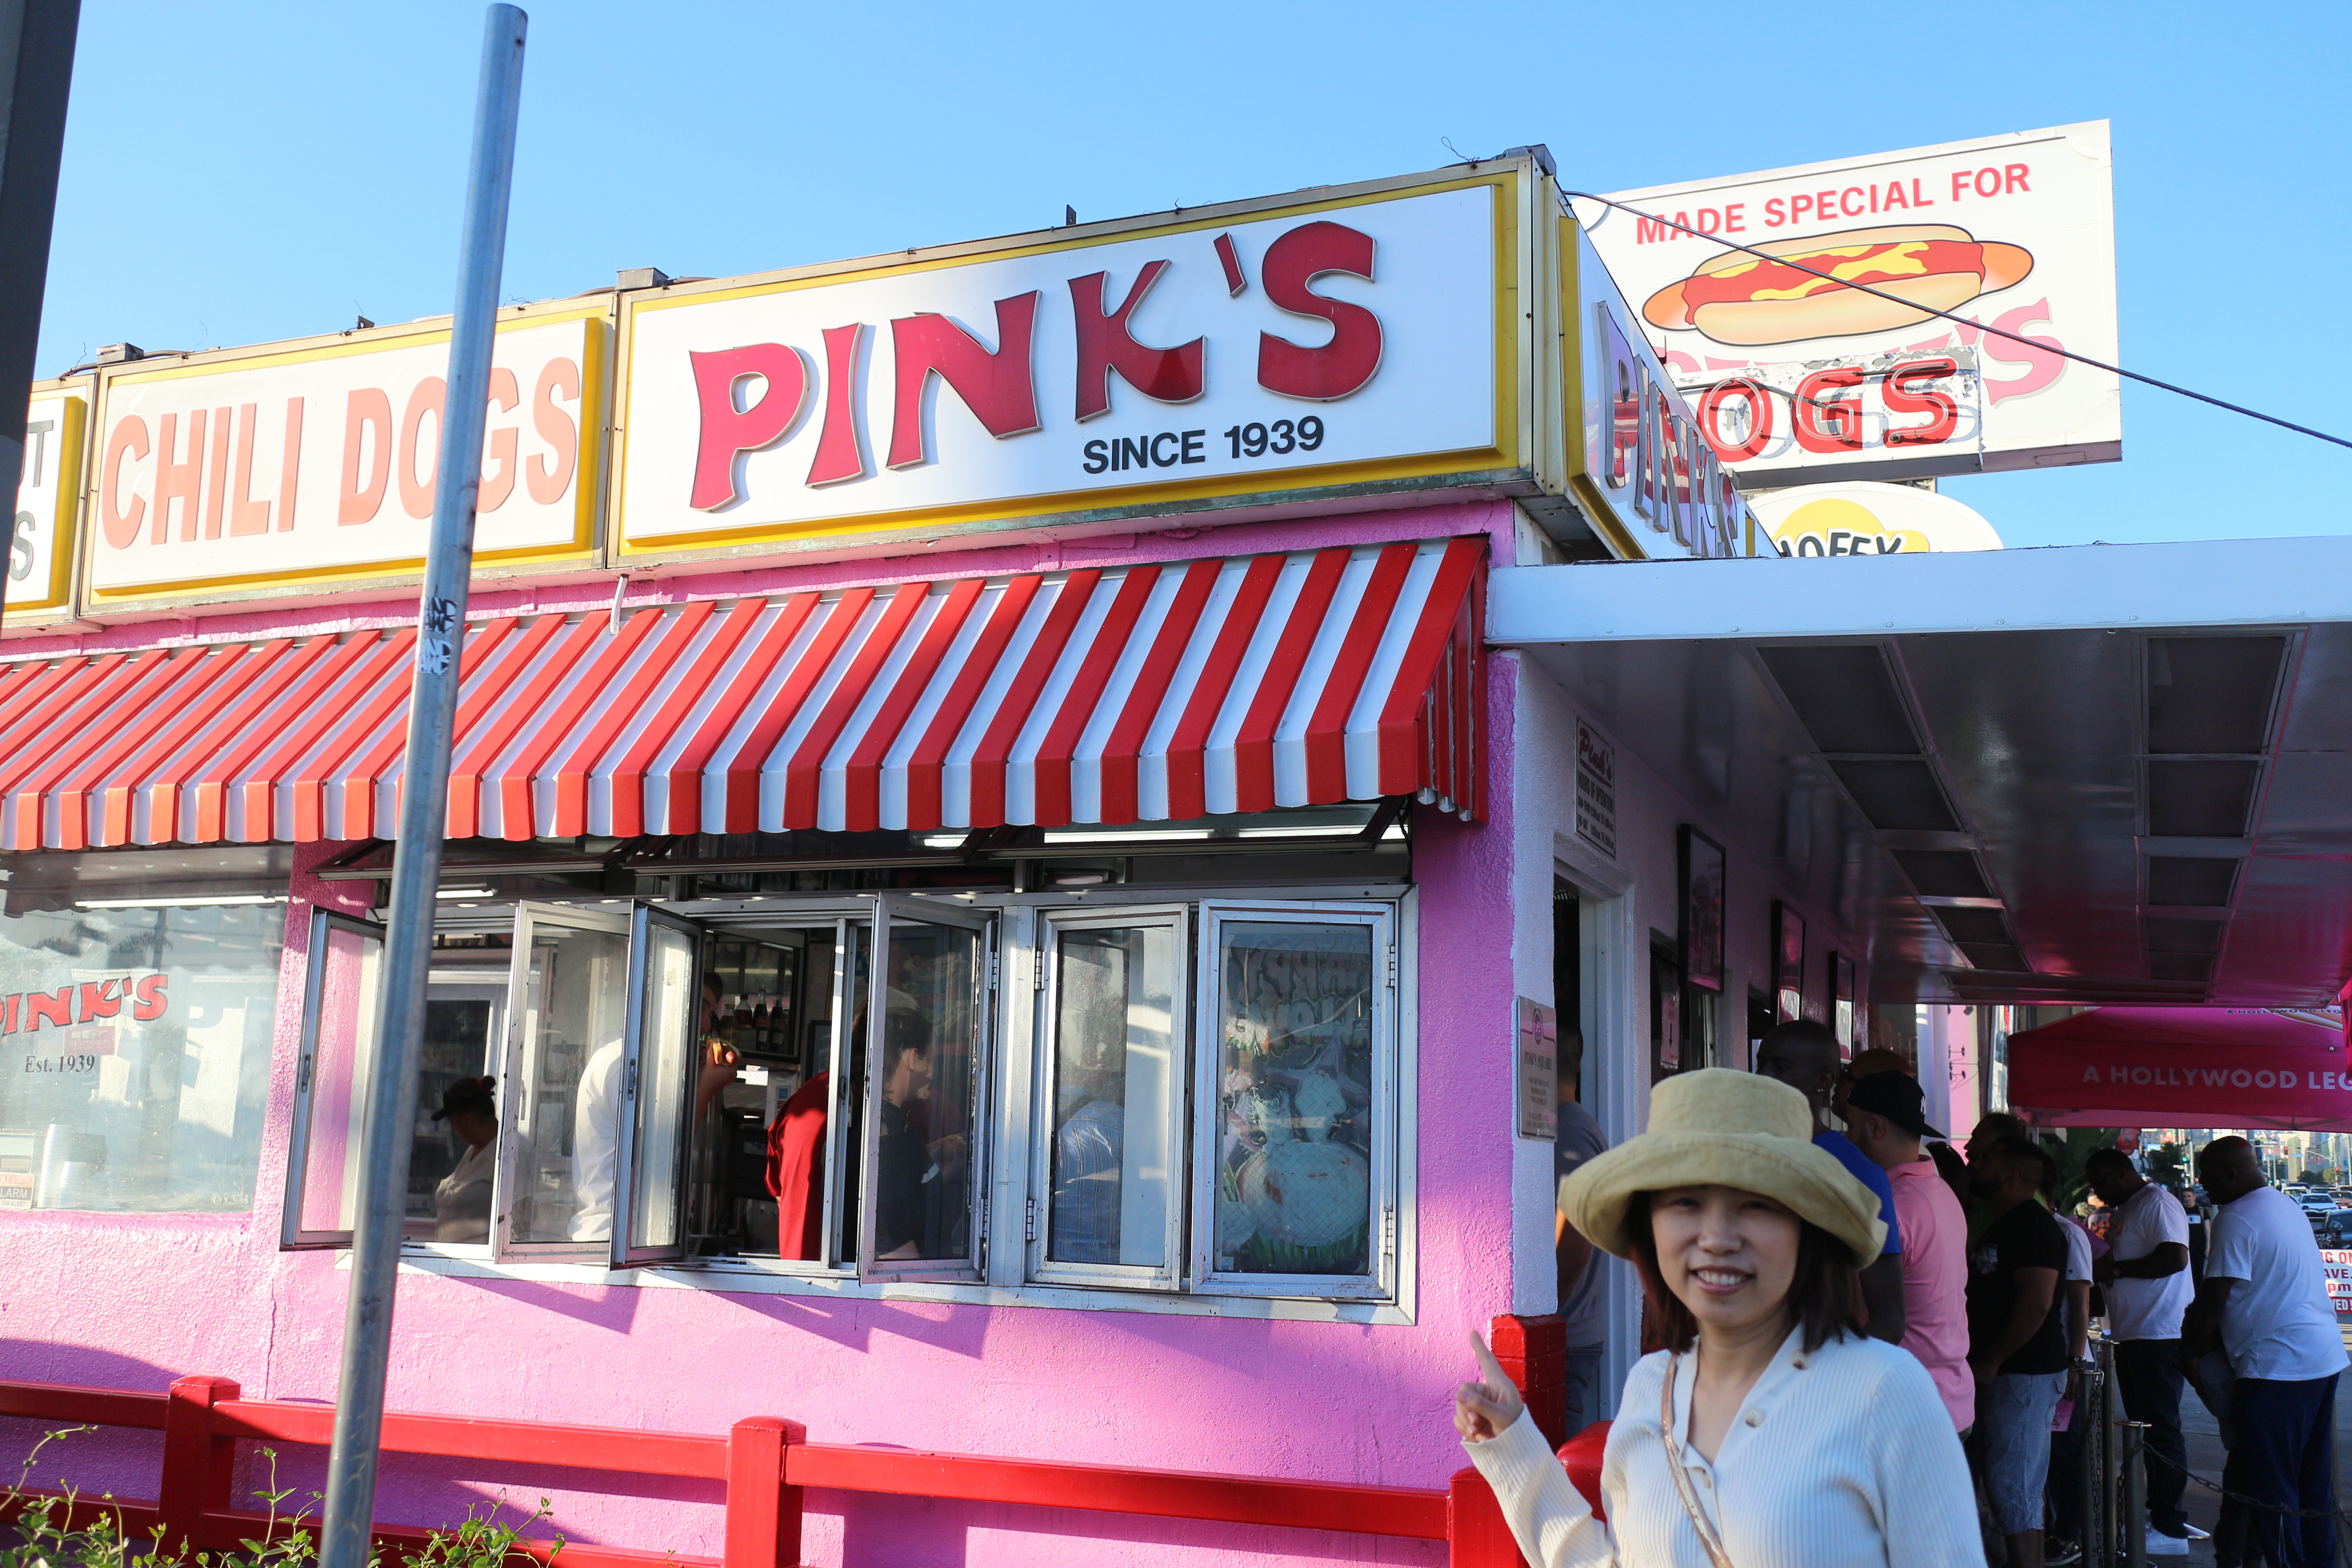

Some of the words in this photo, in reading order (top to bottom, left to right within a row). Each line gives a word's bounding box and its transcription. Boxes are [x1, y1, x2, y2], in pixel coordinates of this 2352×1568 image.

[1636, 203, 1746, 245] MADE
[1764, 178, 1934, 228] SPECIAL
[1951, 162, 2031, 202] FOR
[688, 220, 1384, 513] PINK'S
[1696, 358, 1957, 463] OGS
[101, 396, 304, 550] CHILI
[337, 356, 580, 526] DOGS
[1083, 429, 1206, 475] SINCE
[1223, 416, 1324, 459] 1939
[1579, 728, 1612, 781] Pink's
[24, 1055, 53, 1073] Est.
[57, 1054, 95, 1073] 1939
[2082, 1065, 2102, 1083] A
[2111, 1066, 2298, 1088] HOLLYWOOD
[2308, 1071, 2352, 1091] LEG
[2328, 1283, 2351, 1294] pm
